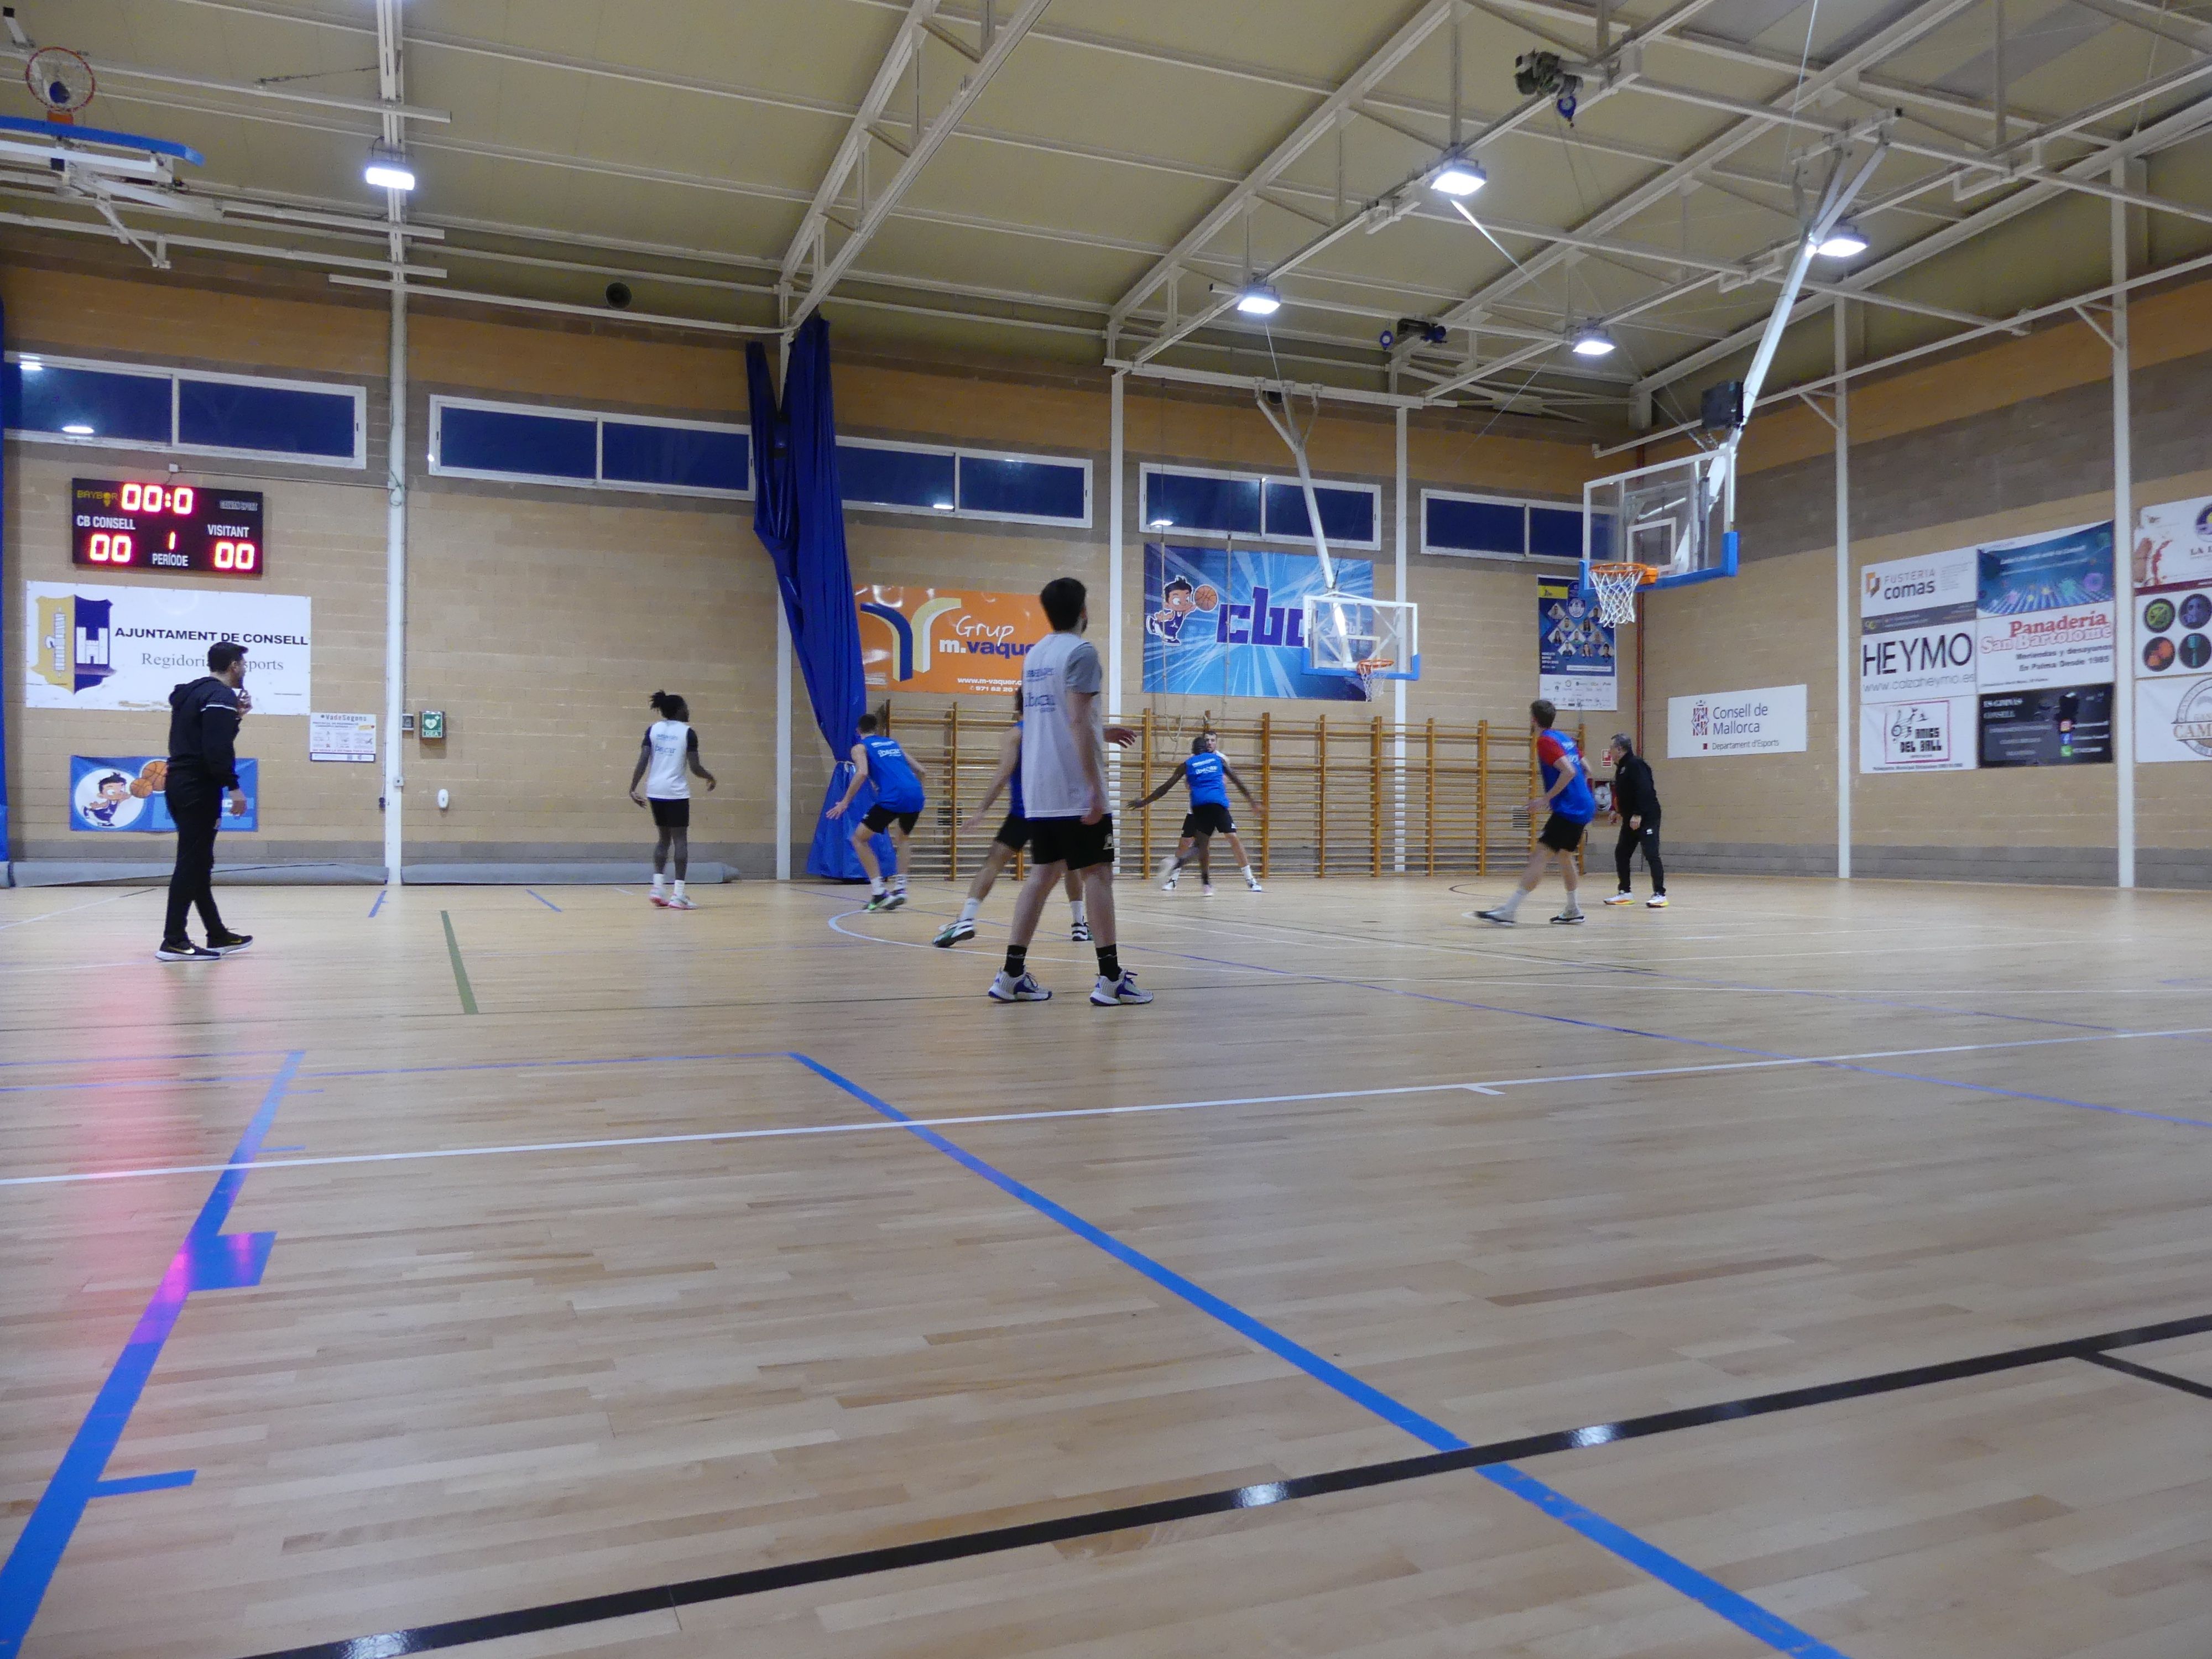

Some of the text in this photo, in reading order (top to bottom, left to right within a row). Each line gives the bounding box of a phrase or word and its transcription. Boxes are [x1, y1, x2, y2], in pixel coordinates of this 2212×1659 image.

[77, 515, 136, 530] CB CONSELL
[207, 524, 249, 538] VISITANT
[90, 534, 131, 562] 00
[215, 542, 254, 569] 00
[152, 553, 189, 566] PERÍODE
[1884, 580, 1936, 600] comas
[115, 627, 308, 645] AJUNTAMENT DE CONSELL
[956, 615, 1014, 646] Grup
[940, 639, 1036, 659] m.vaqu
[1863, 633, 1972, 677] HEYMO
[142, 653, 207, 669] Regidori
[244, 660, 284, 671] sports
[1713, 701, 1768, 719] Consell de
[1713, 721, 1760, 735] Mallorca
[1712, 741, 1750, 751] Departament
